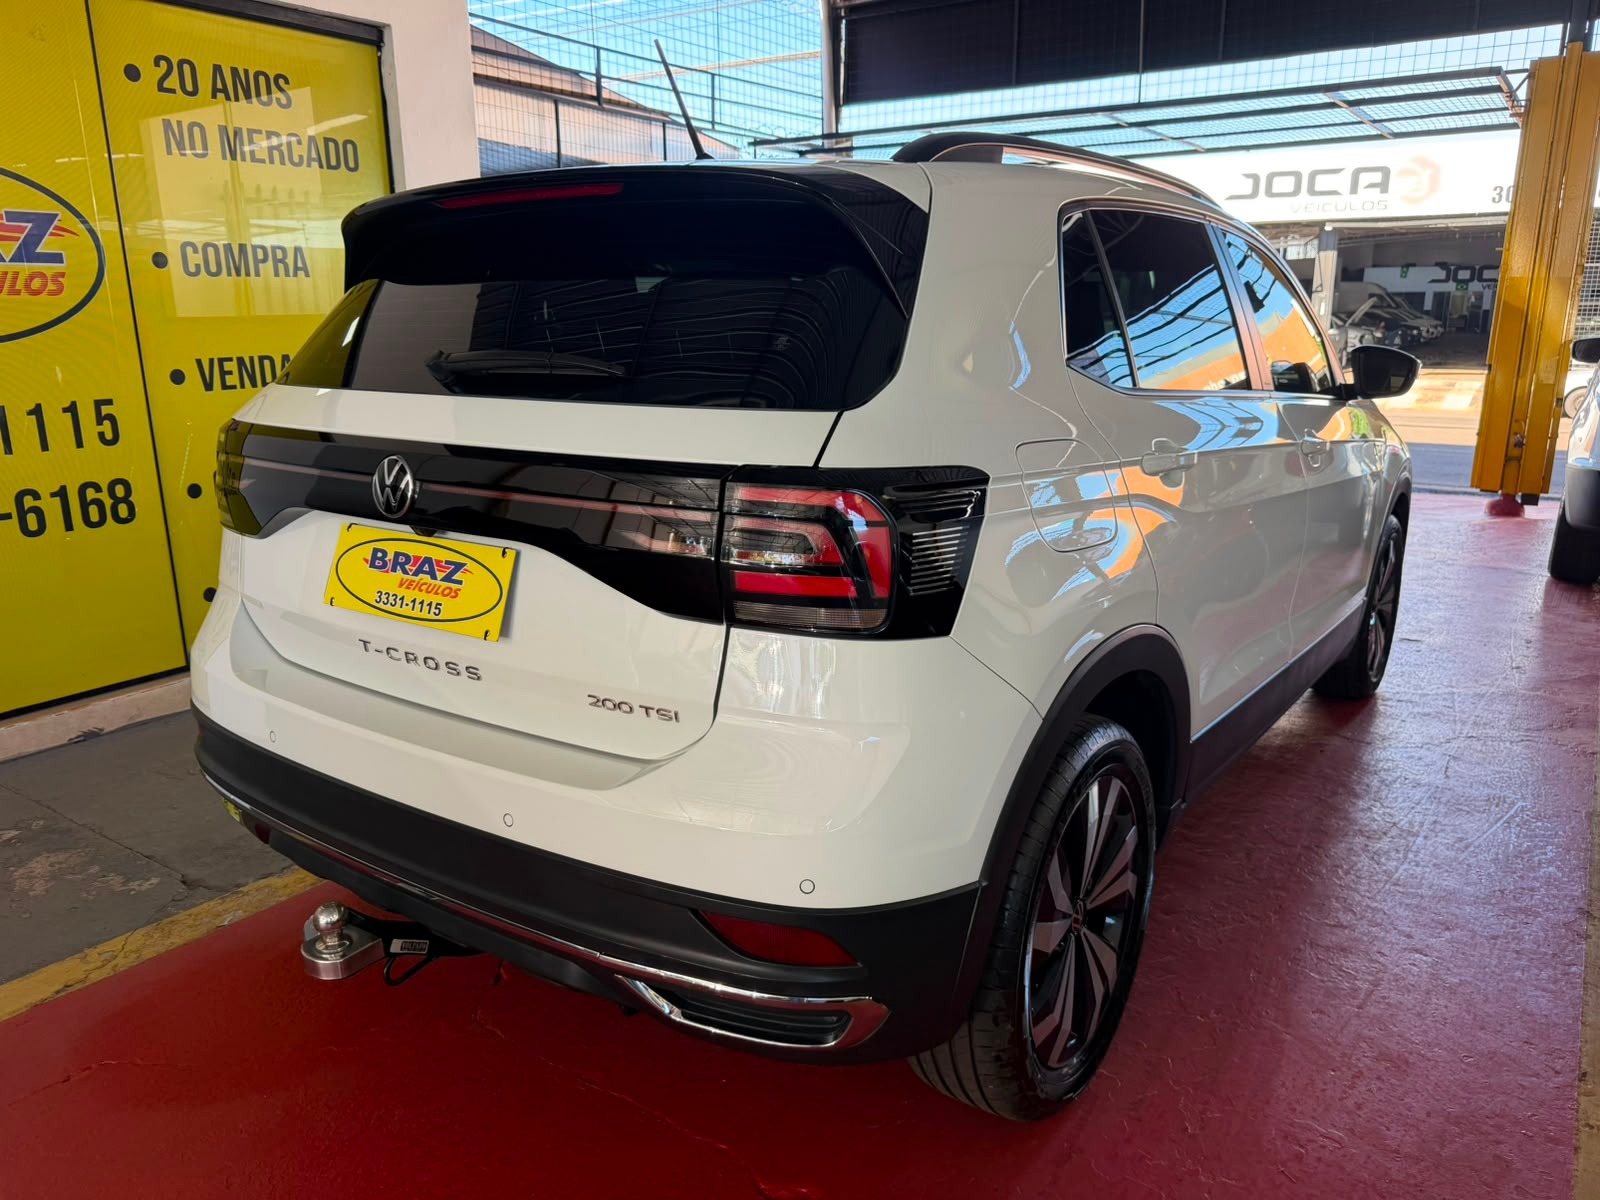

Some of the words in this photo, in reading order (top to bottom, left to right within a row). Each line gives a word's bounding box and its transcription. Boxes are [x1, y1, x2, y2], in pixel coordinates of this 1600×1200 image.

[154, 54, 199, 97] 20
[210, 63, 293, 110] ANOS
[162, 118, 208, 159] NO
[218, 124, 360, 172] MERCADO
[1224, 166, 1391, 200] JOCA
[180, 240, 311, 279] COMPRA
[368, 547, 469, 587] BRAZ
[375, 590, 443, 617] 3331-1115
[398, 577, 462, 599] VEÍCULOS
[358, 638, 482, 681] T-CROSS
[587, 694, 635, 714] 200
[639, 704, 680, 723] TSI
